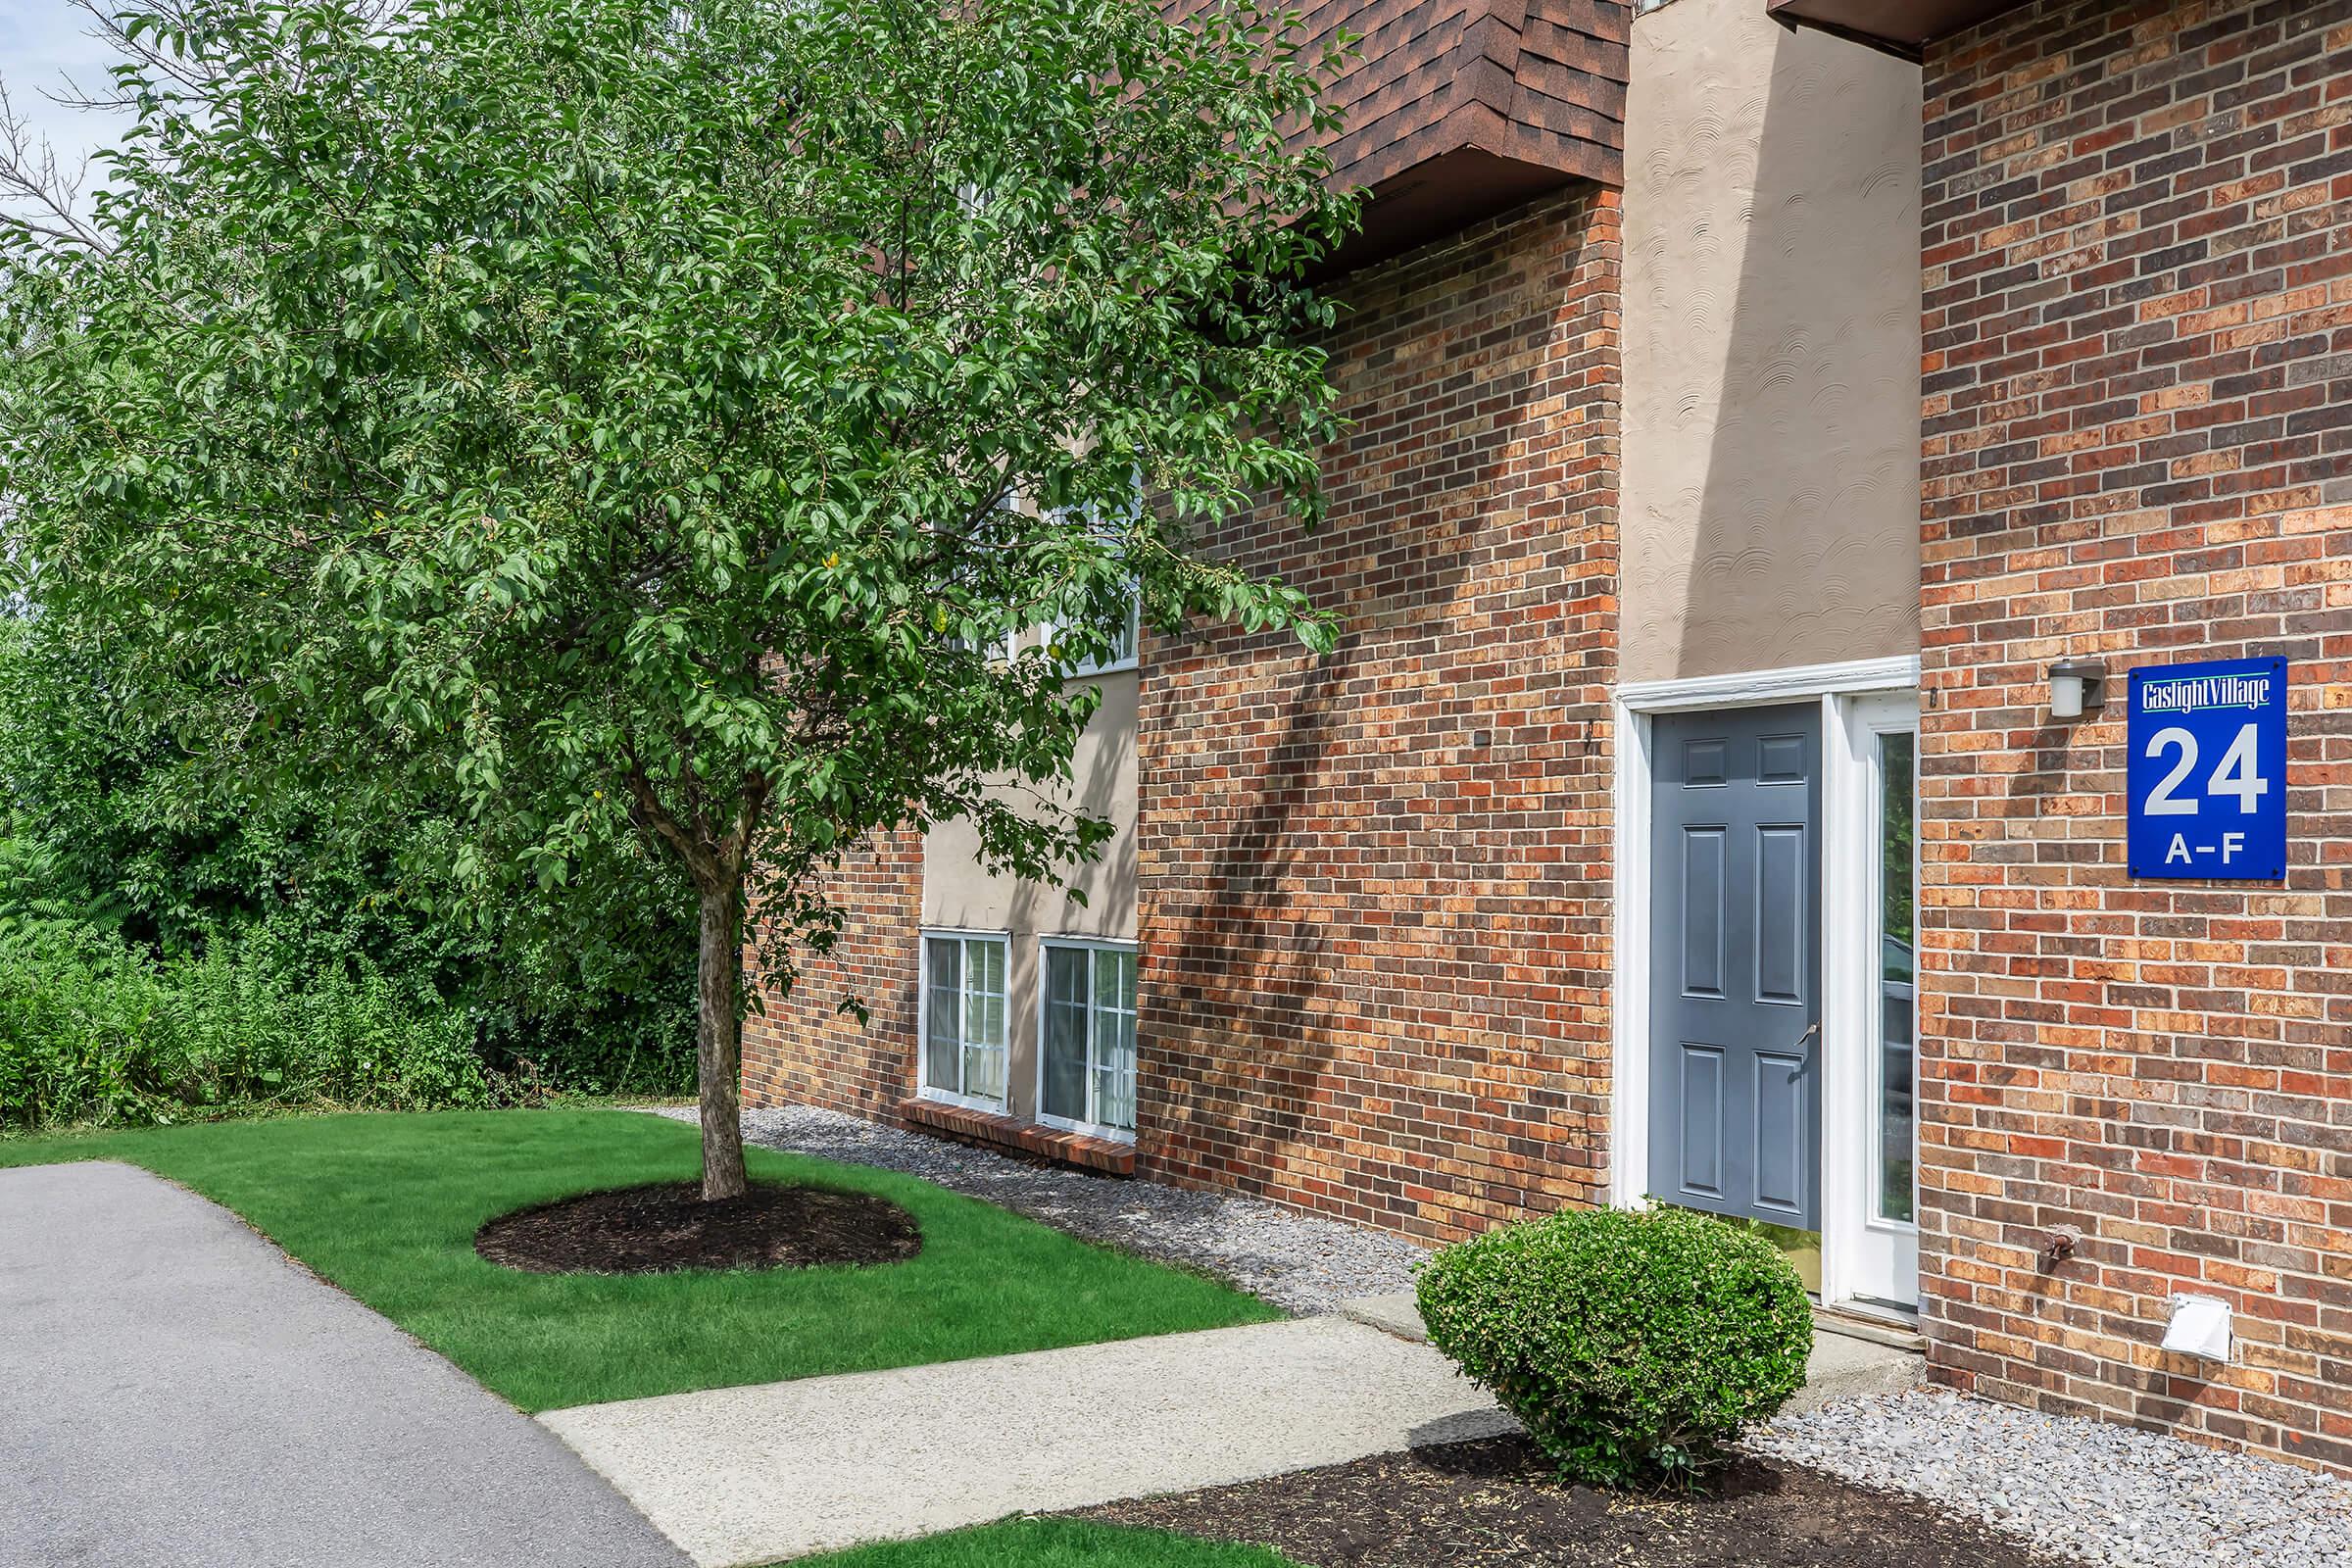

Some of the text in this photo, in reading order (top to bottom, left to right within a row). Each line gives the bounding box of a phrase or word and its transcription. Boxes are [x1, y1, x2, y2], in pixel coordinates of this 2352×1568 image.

[2142, 677, 2270, 714] Gaslight Village
[2144, 723, 2268, 815] 24
[2165, 832, 2245, 863] A-F
